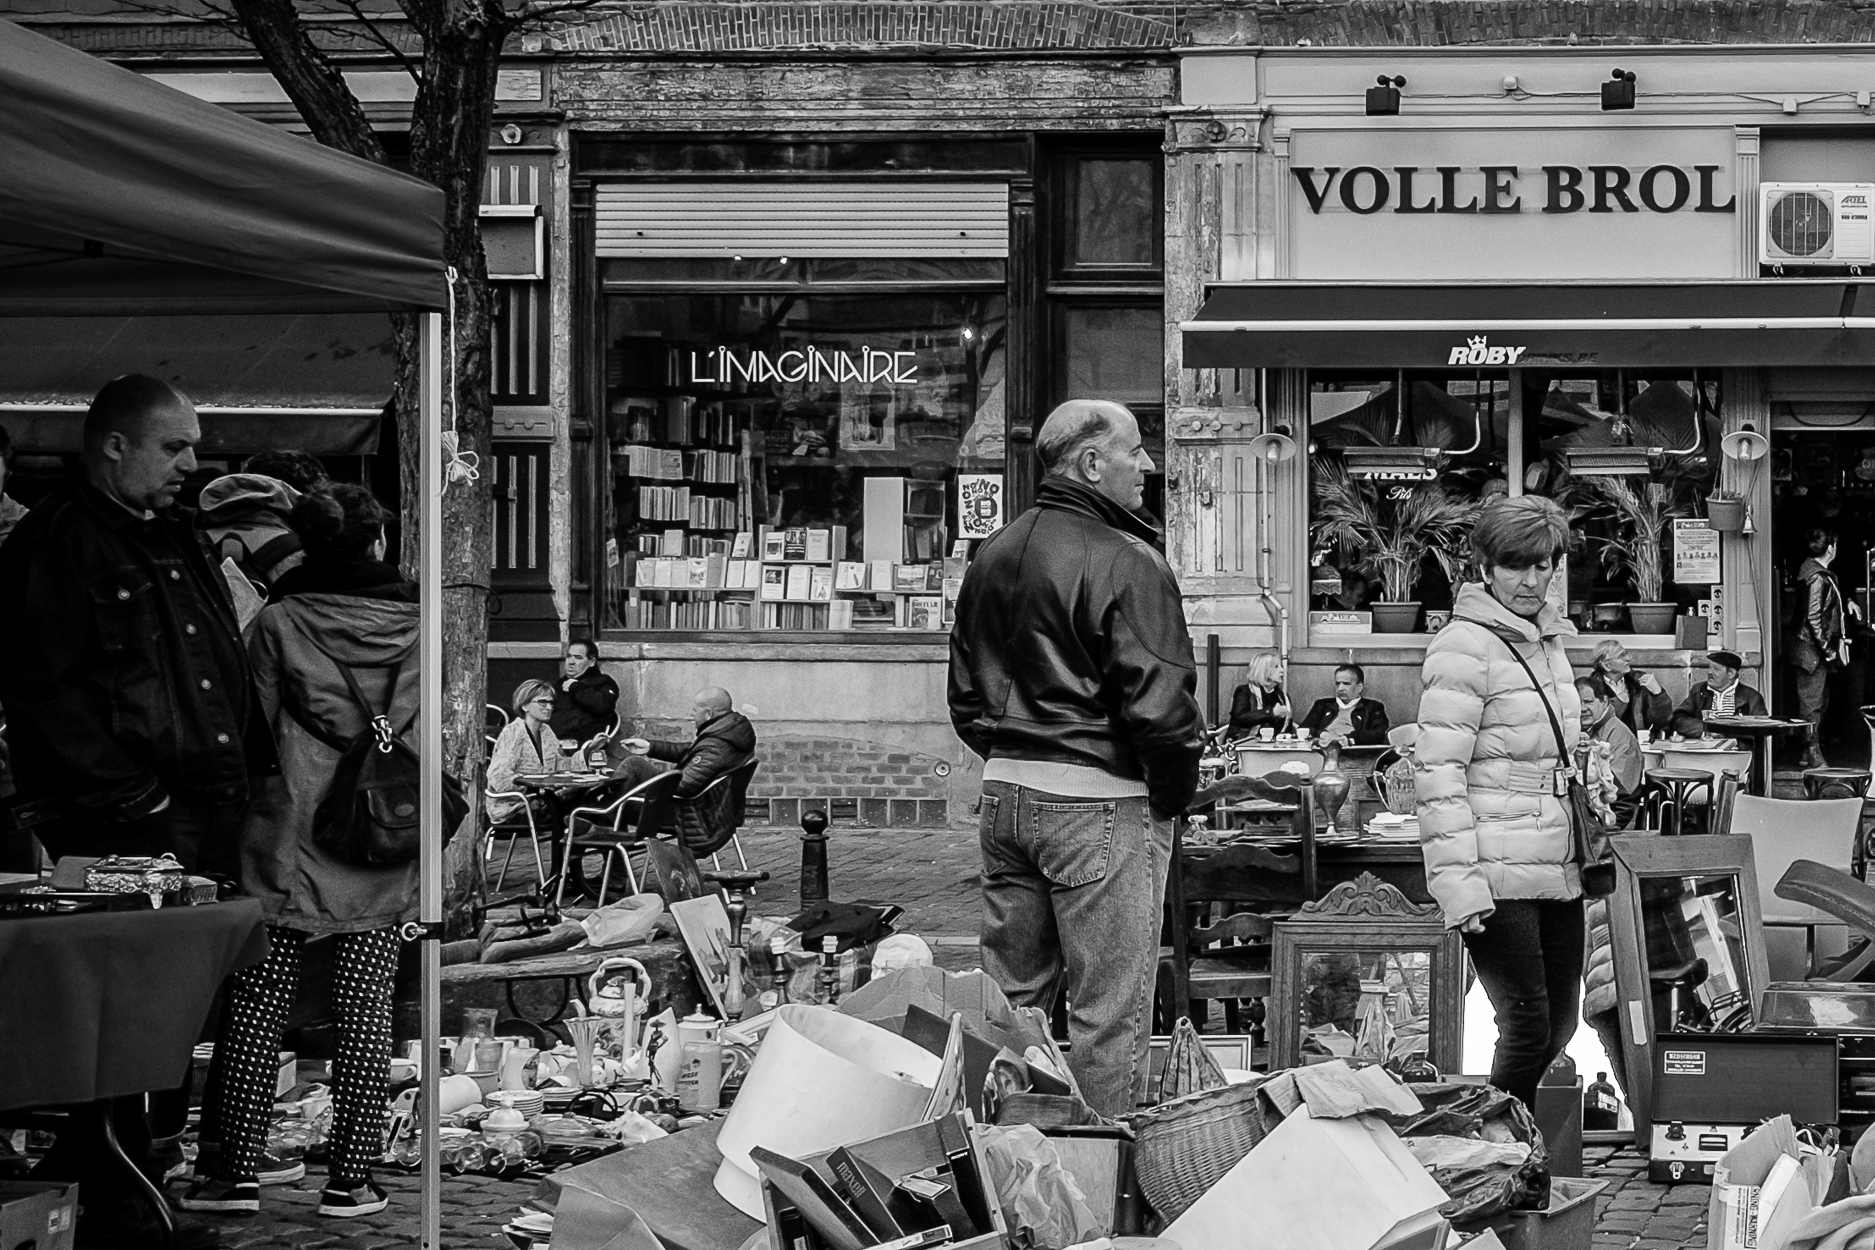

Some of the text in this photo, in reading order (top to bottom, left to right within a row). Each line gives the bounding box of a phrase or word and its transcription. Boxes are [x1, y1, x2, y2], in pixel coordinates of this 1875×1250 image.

[1289, 165, 1737, 214] VOLLE BROL
[692, 345, 918, 383] L'IMAGINAIRE
[1448, 346, 1526, 365] ROBY
[1385, 485, 1414, 500] Pils
[836, 1161, 868, 1199] maxell
